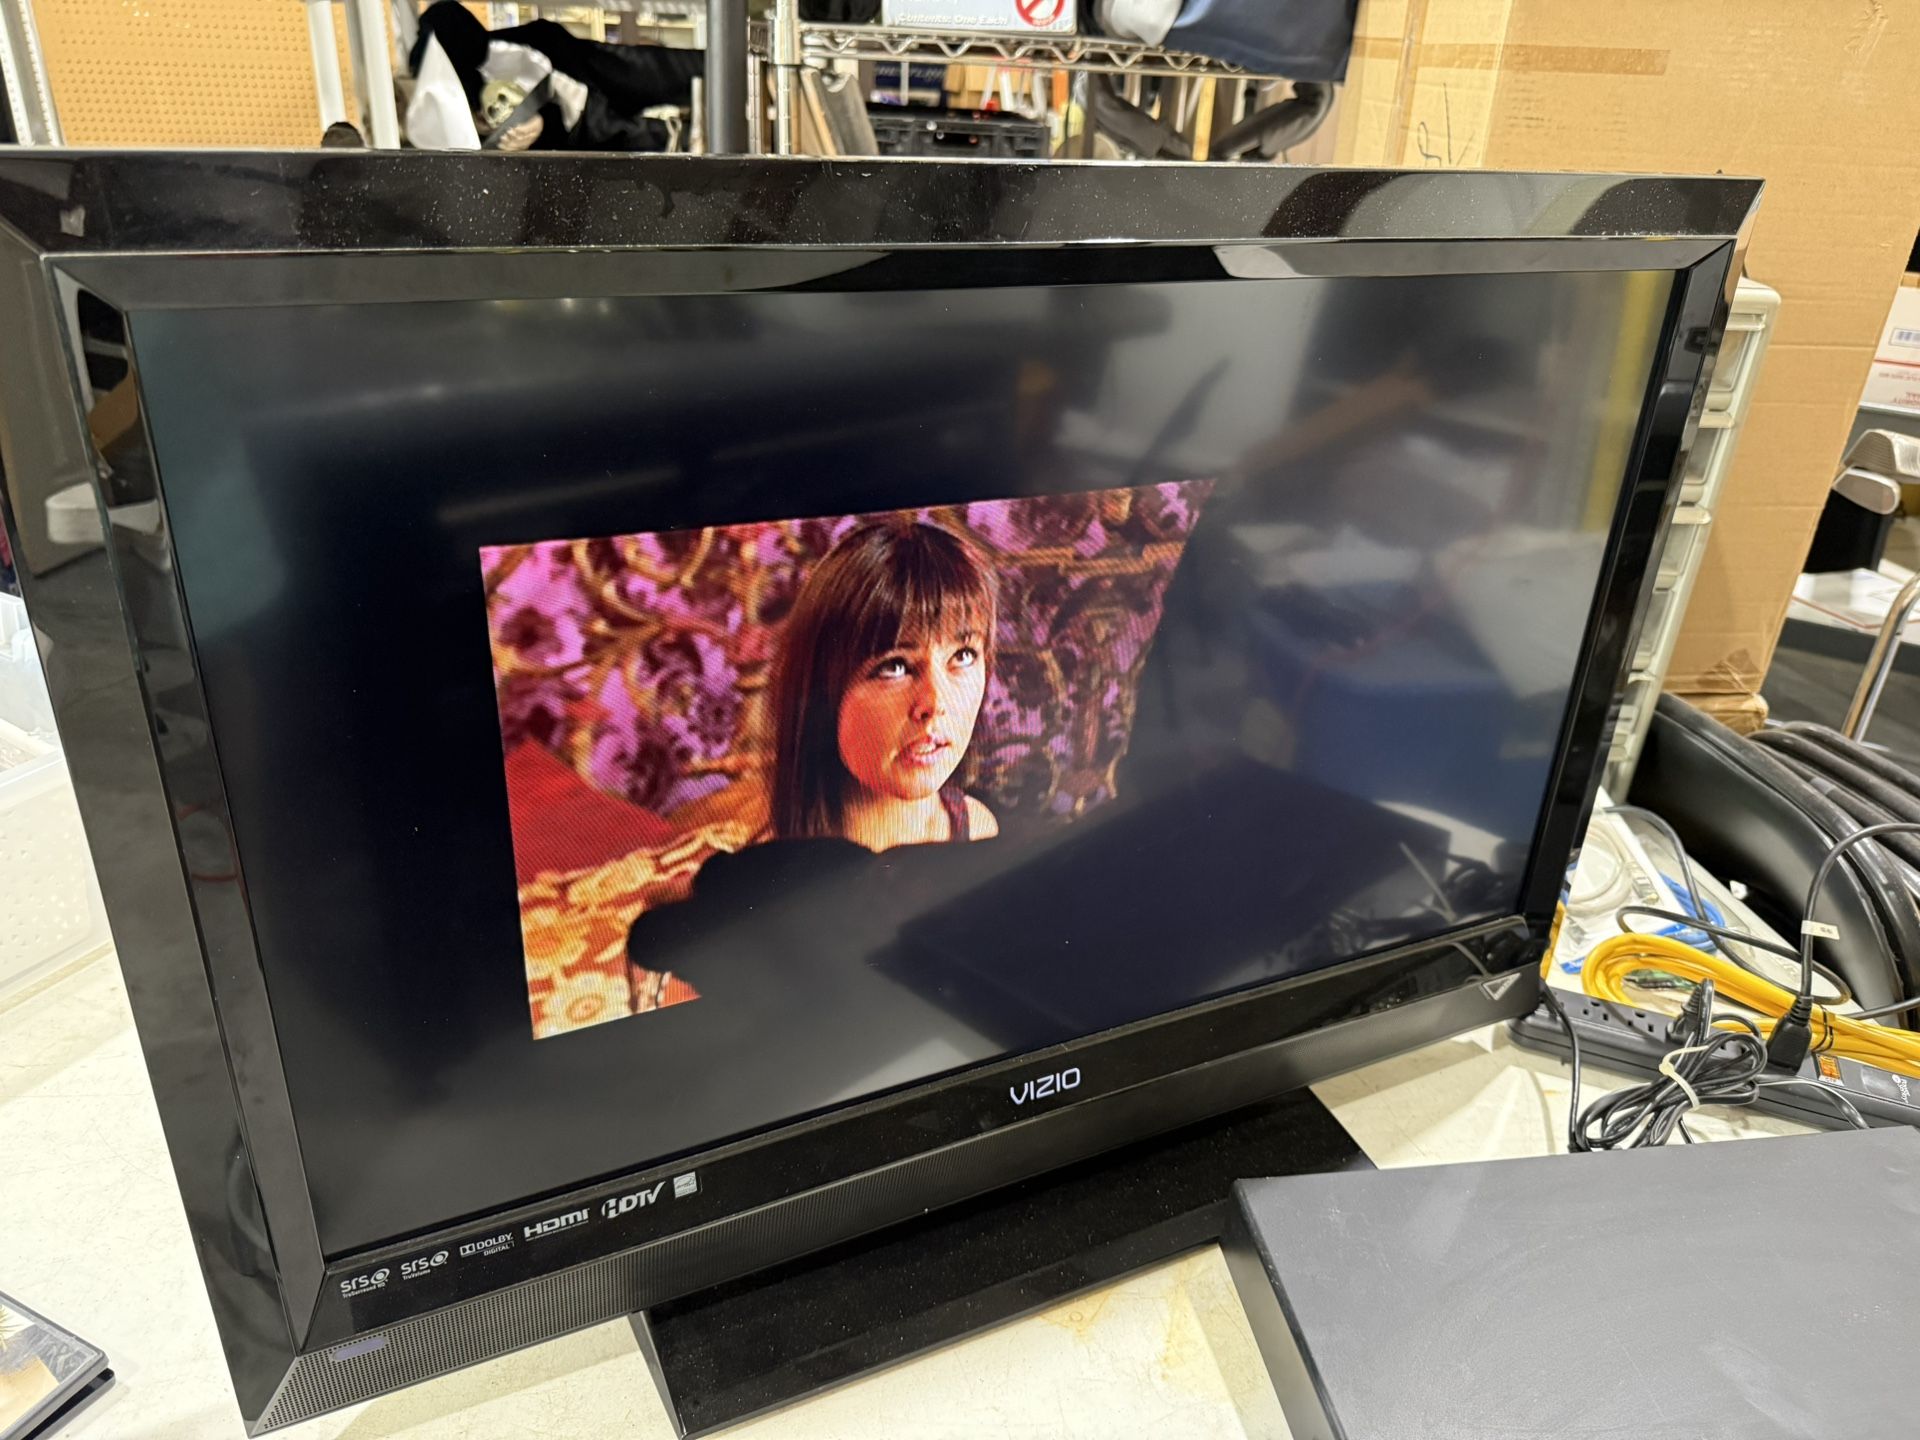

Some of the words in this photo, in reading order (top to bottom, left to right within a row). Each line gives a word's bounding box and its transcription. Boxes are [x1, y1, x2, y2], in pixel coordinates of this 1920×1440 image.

[1009, 1067, 1081, 1105] VIZIO
[601, 1181, 666, 1219] HDTV
[523, 1207, 590, 1238] HDMI
[476, 1232, 513, 1250] DOLBY
[483, 1243, 511, 1256] DIGITAL
